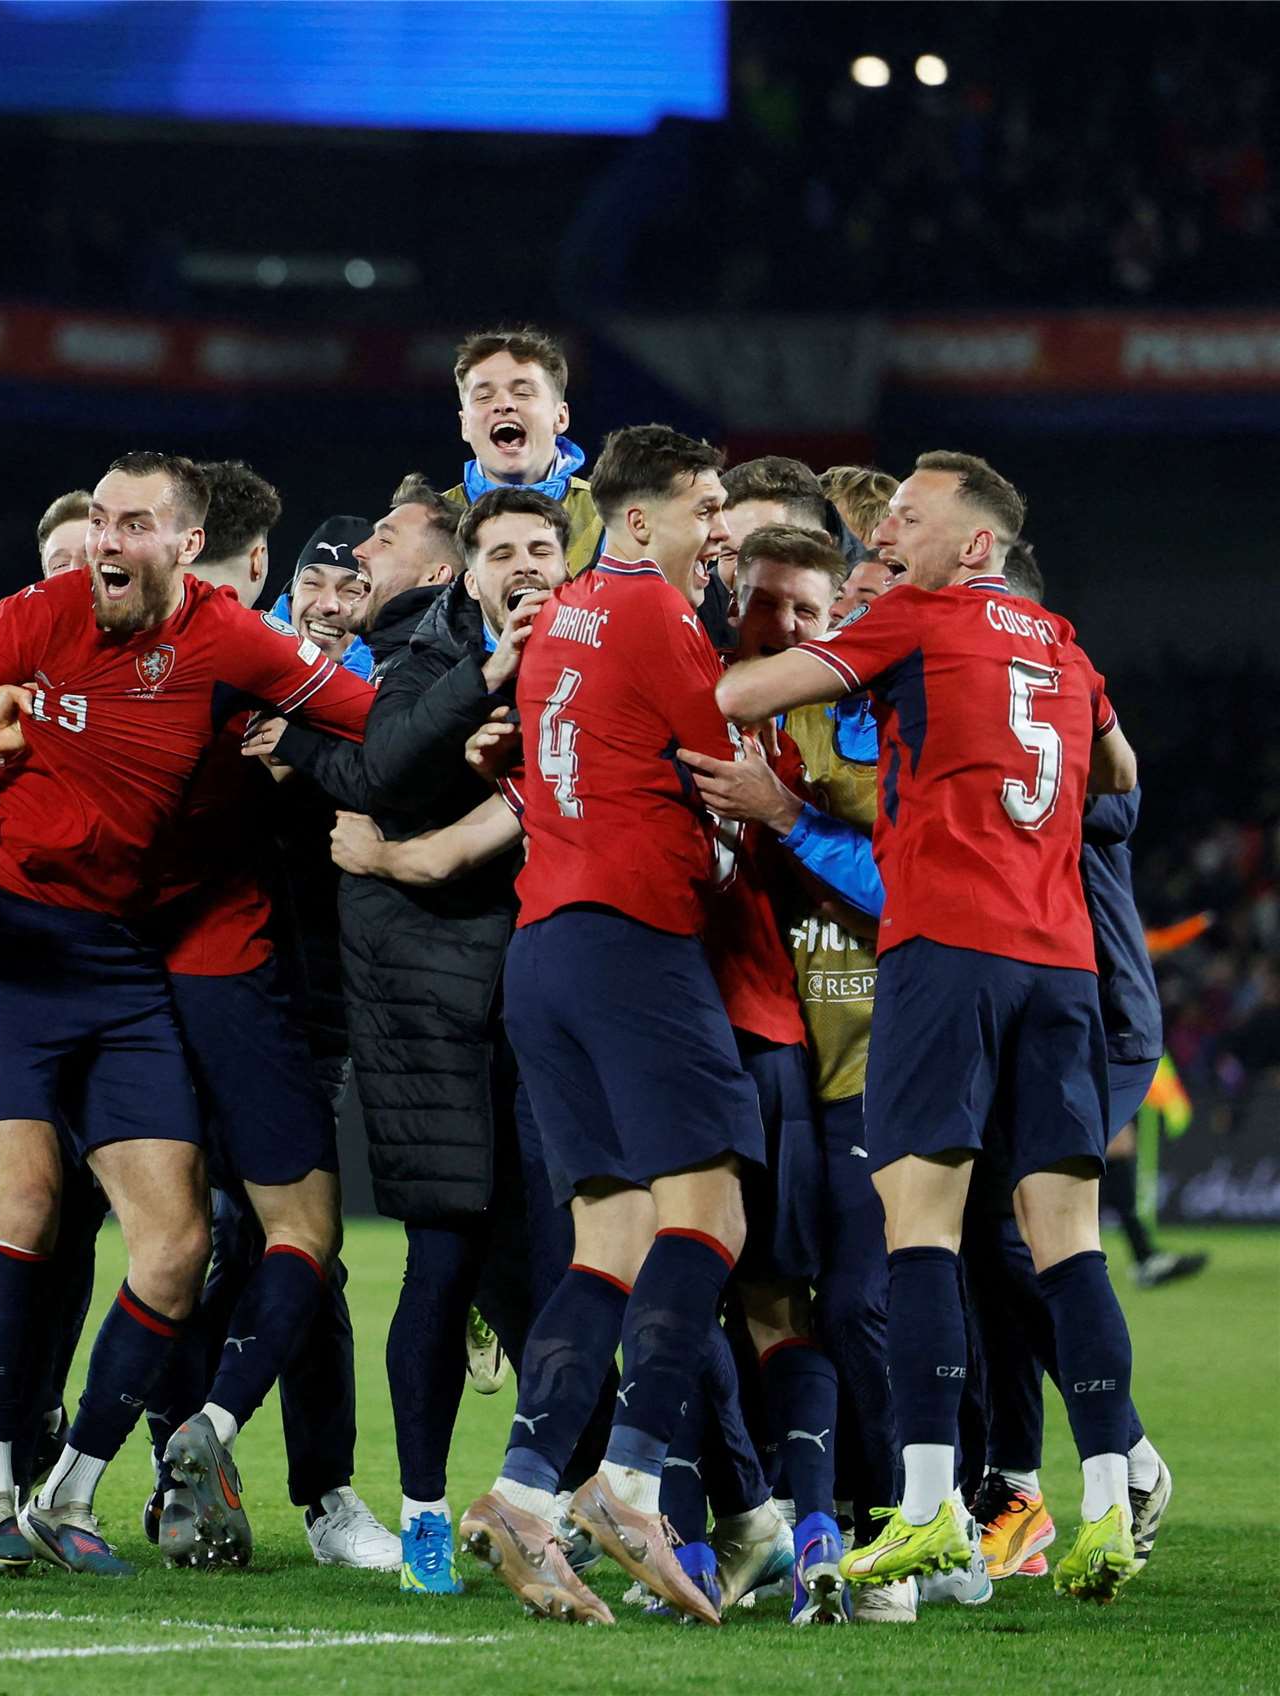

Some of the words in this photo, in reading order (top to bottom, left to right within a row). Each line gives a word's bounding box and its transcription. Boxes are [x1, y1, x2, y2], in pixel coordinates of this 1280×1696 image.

[32, 689, 88, 733] 19
[538, 667, 584, 819] 4
[1001, 656, 1062, 830] 5
[825, 975, 878, 996] RESP
[936, 1365, 967, 1379] CZE
[1073, 1379, 1117, 1393] CZE
[119, 1393, 145, 1408] CZ
